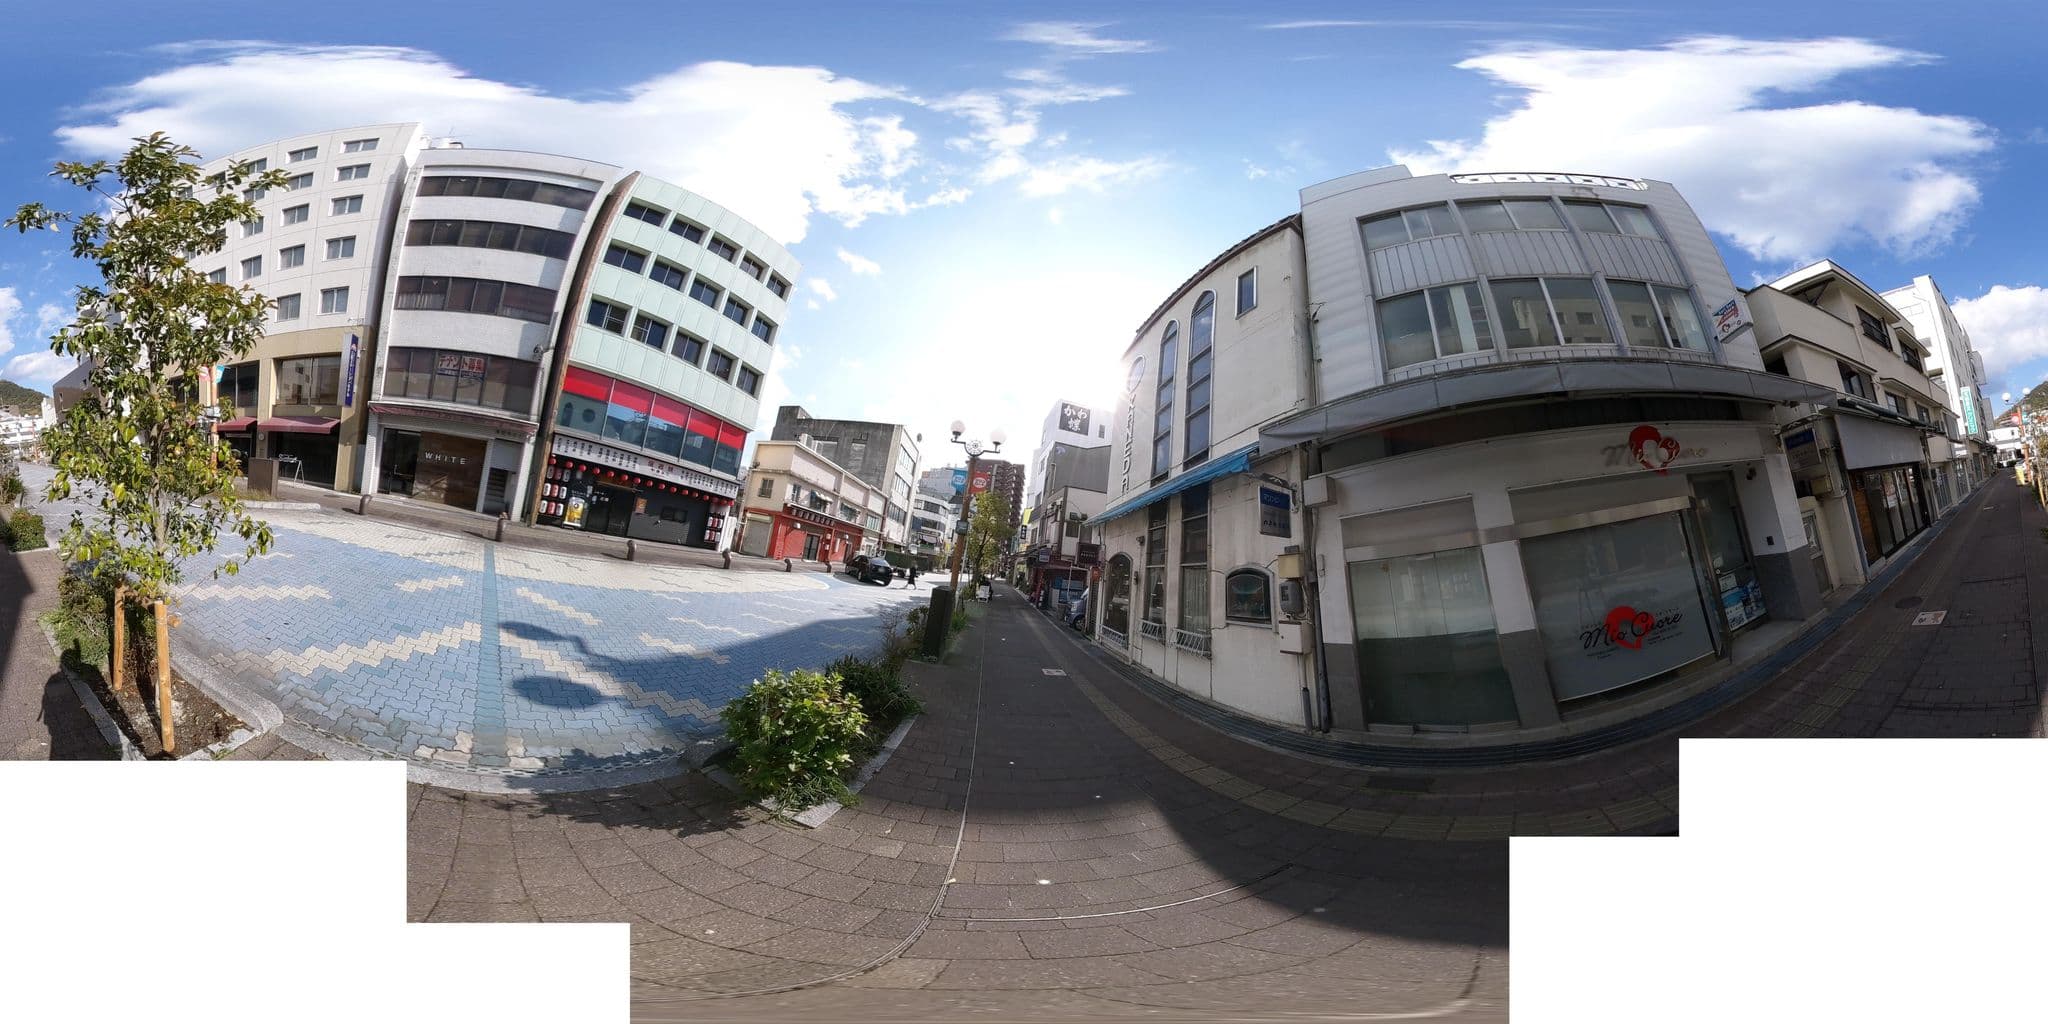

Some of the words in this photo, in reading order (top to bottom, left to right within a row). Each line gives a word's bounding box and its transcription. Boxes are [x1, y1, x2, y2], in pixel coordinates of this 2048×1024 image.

[1063, 405, 1088, 419] かわ
[425, 452, 467, 465] WHITE
[1579, 623, 1628, 650] Mio
[1630, 611, 1683, 638] Cuore
